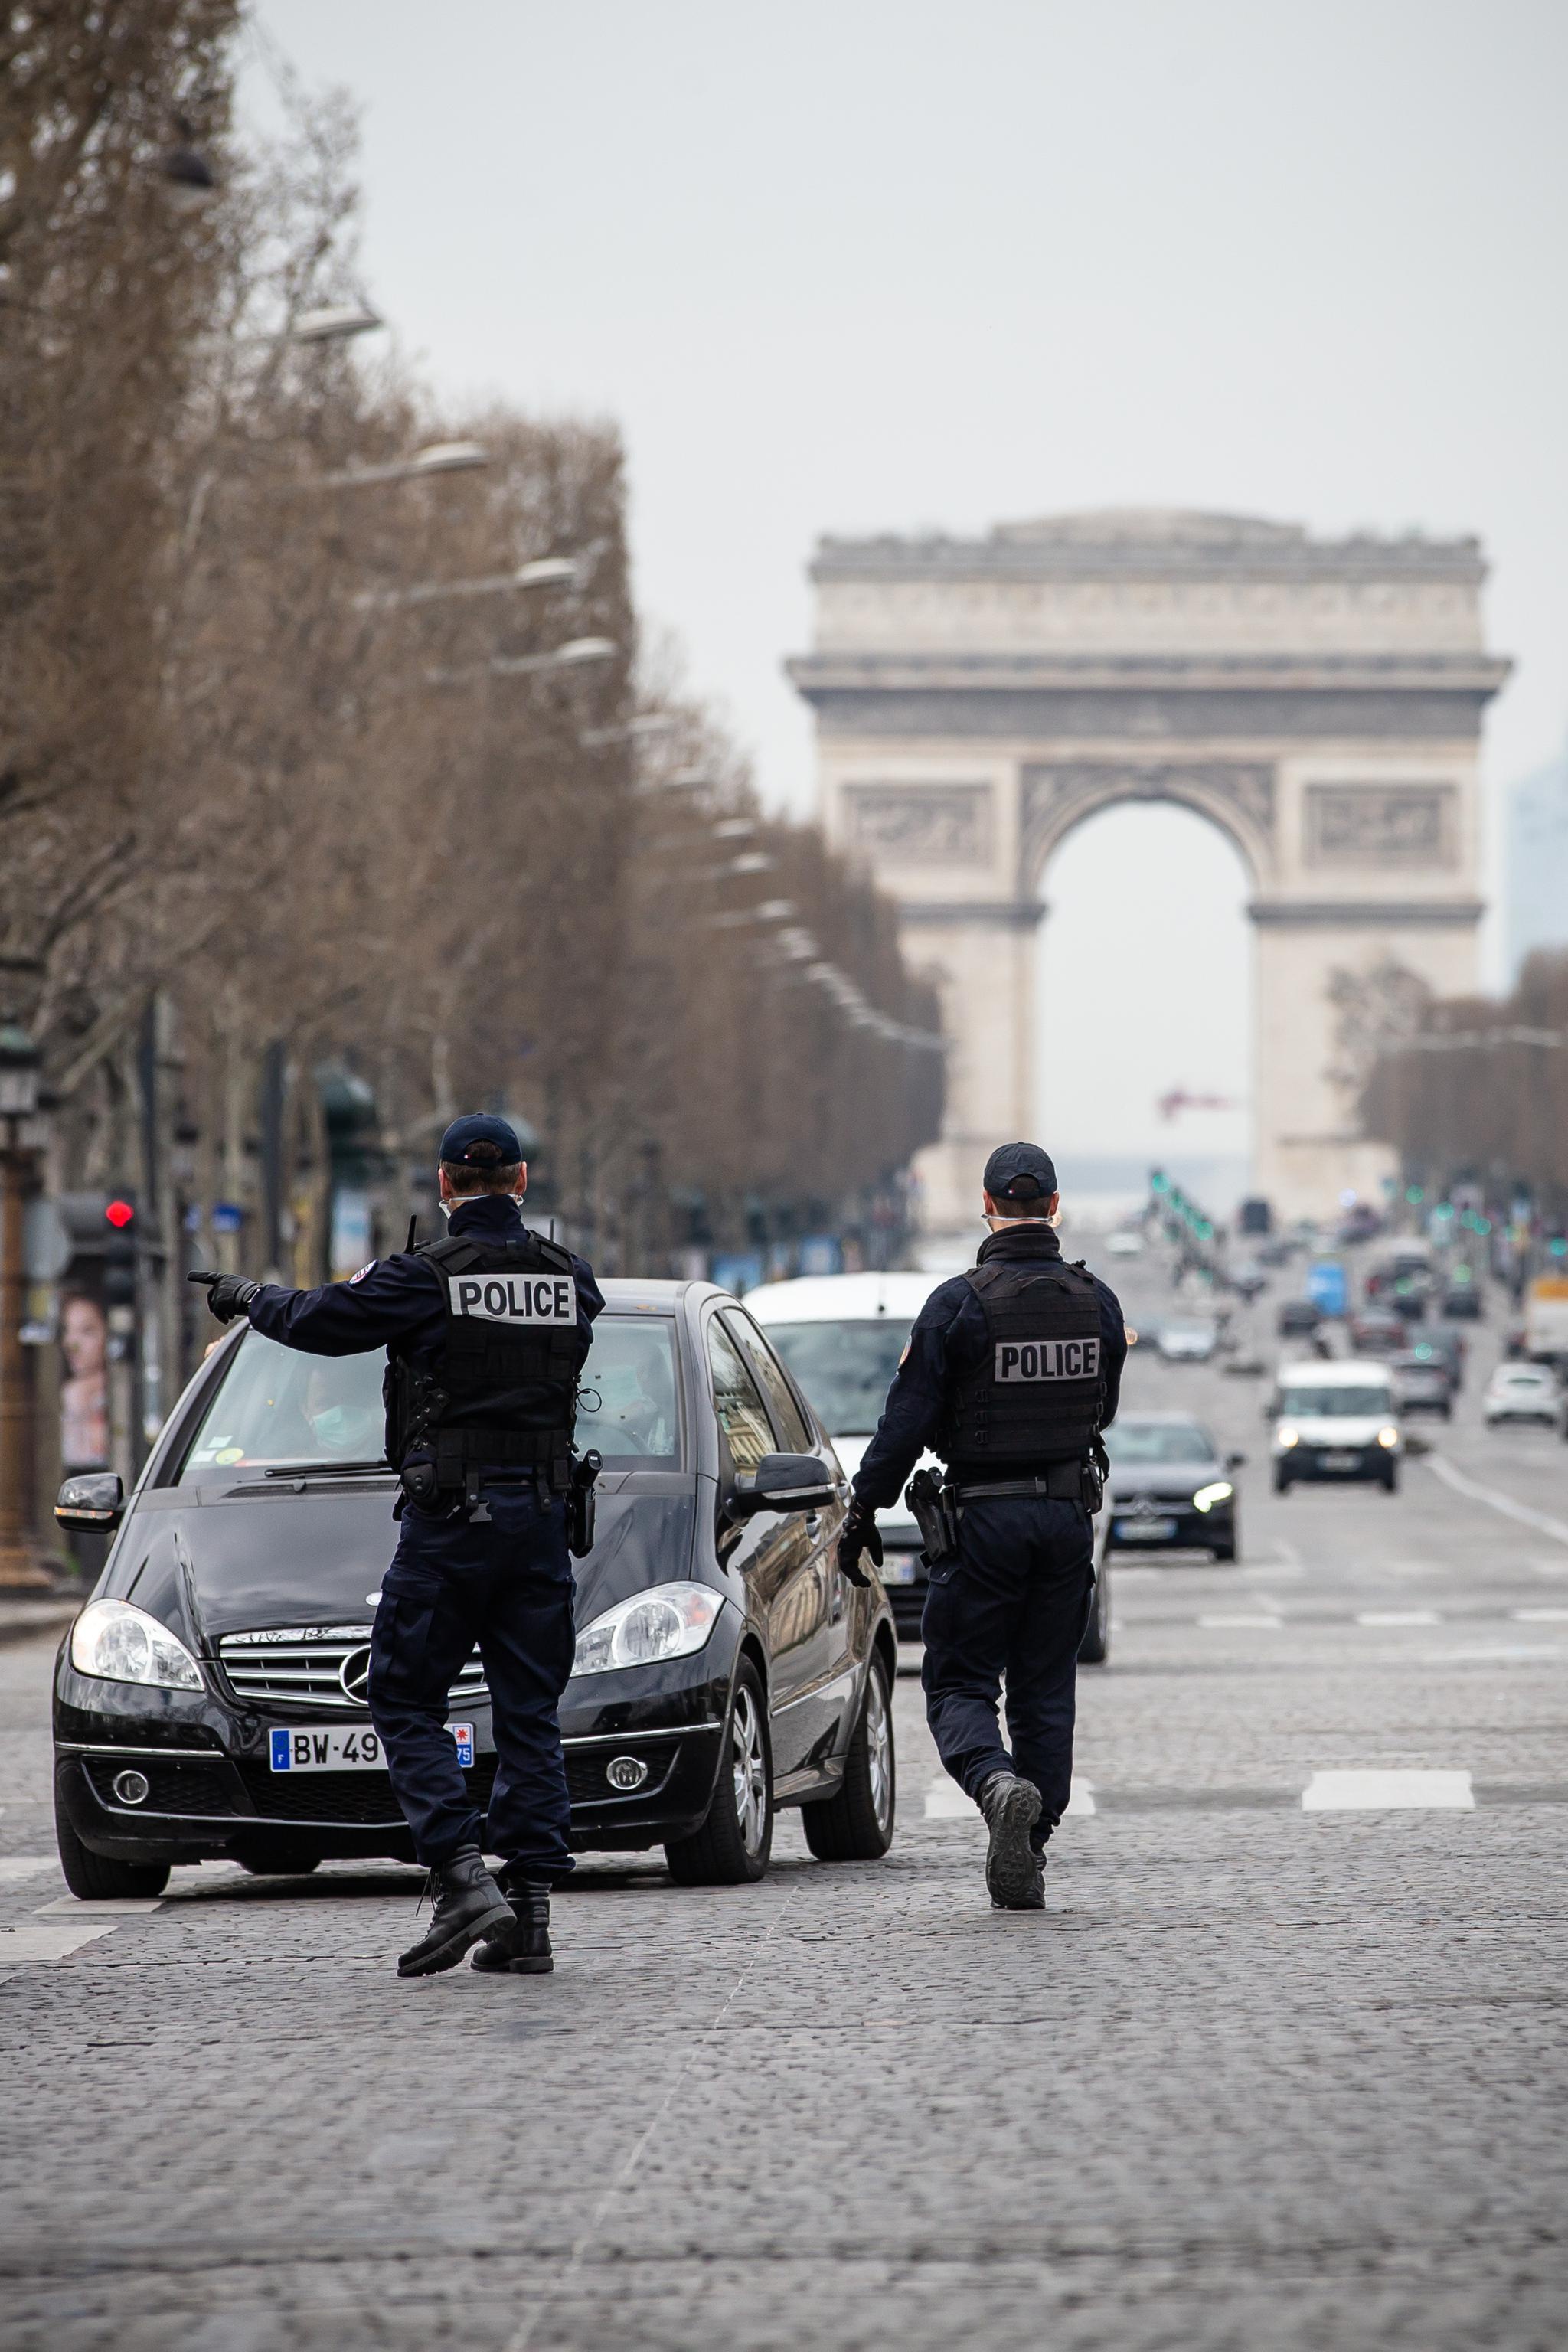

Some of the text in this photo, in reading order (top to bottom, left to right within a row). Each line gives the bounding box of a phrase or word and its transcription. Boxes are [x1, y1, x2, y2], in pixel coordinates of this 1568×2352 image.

[459, 1281, 570, 1318] POLICE
[1001, 1342, 1096, 1378] POLICE
[278, 1754, 284, 1764] F
[457, 1748, 470, 1761] 75
